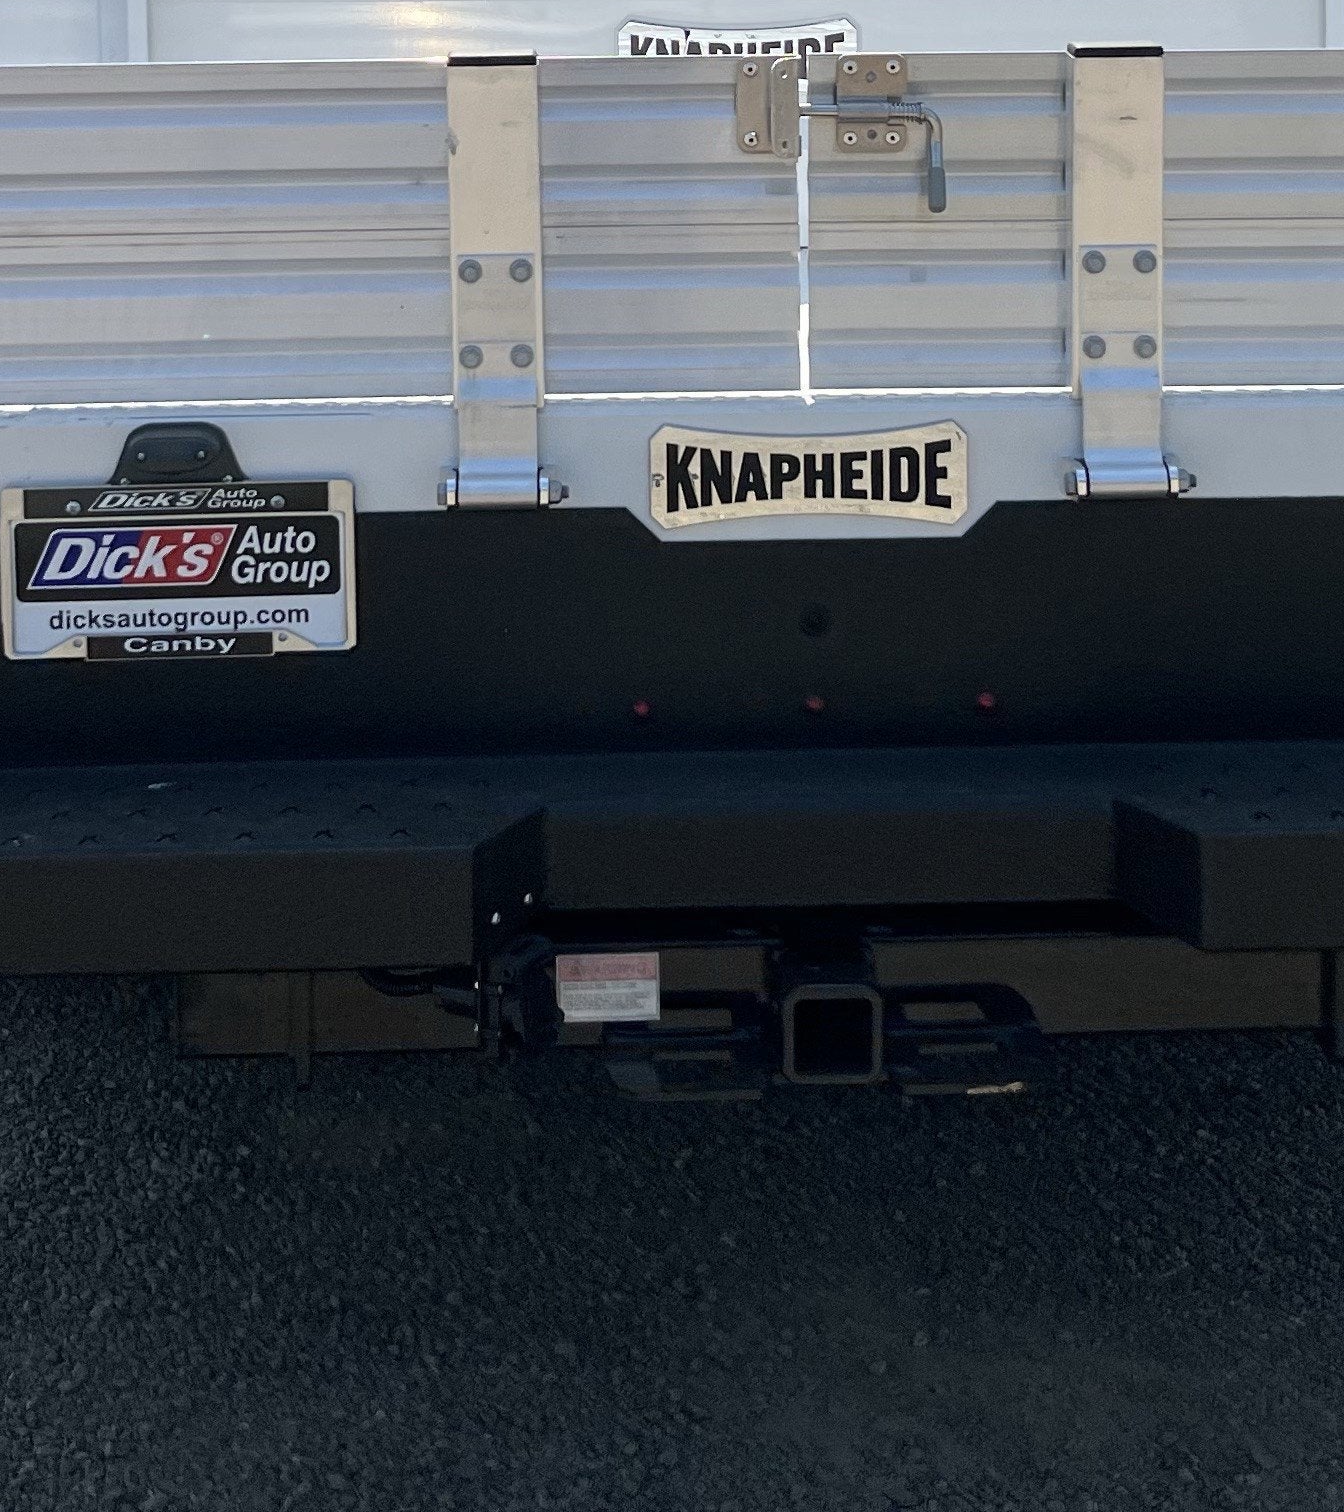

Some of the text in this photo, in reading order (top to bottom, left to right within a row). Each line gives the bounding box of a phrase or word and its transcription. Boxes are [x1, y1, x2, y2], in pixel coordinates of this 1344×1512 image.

[666, 439, 952, 513] KNAPHEIDE
[97, 490, 199, 509] Dick's
[207, 497, 266, 510] Group
[212, 488, 258, 499] Auto
[237, 526, 317, 555] Auto
[43, 532, 215, 581] Dick's
[231, 556, 331, 588] Group
[49, 607, 310, 633] dicksautogroup.com
[123, 636, 236, 655] Canby
